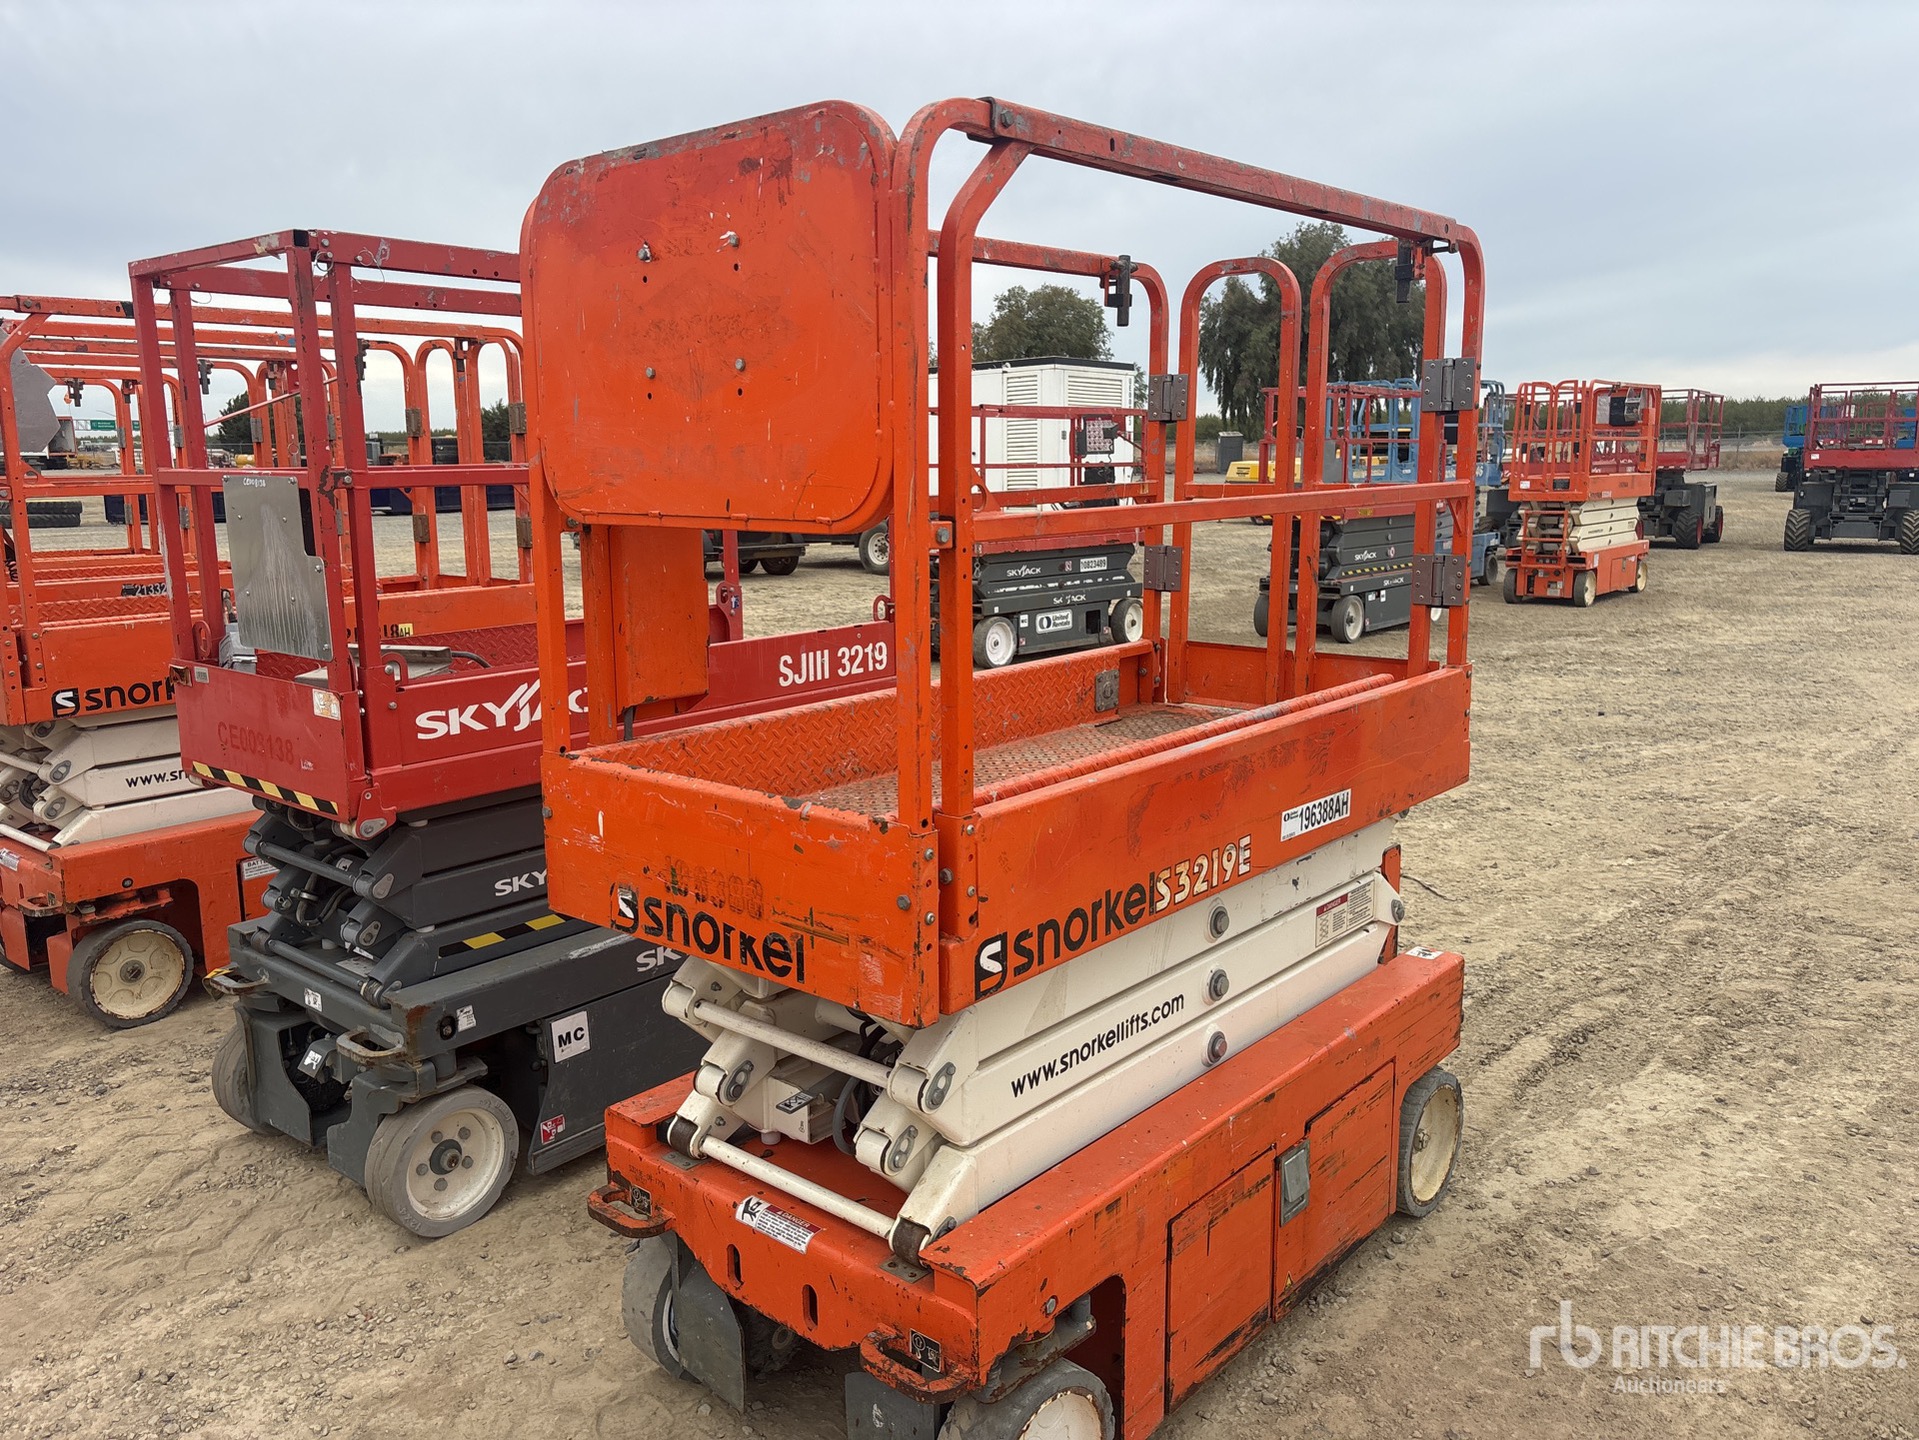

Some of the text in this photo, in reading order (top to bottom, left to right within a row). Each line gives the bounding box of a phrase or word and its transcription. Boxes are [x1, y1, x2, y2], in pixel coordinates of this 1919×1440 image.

[1006, 564, 1042, 577] SKYJACK
[837, 641, 888, 677] 3219
[1299, 791, 1349, 831] 196388AH
[1153, 834, 1252, 914] S3219E
[643, 896, 806, 984] snorkel
[1013, 871, 1156, 979] snorkel
[1010, 993, 1185, 1098] www.snorkellifts.com
